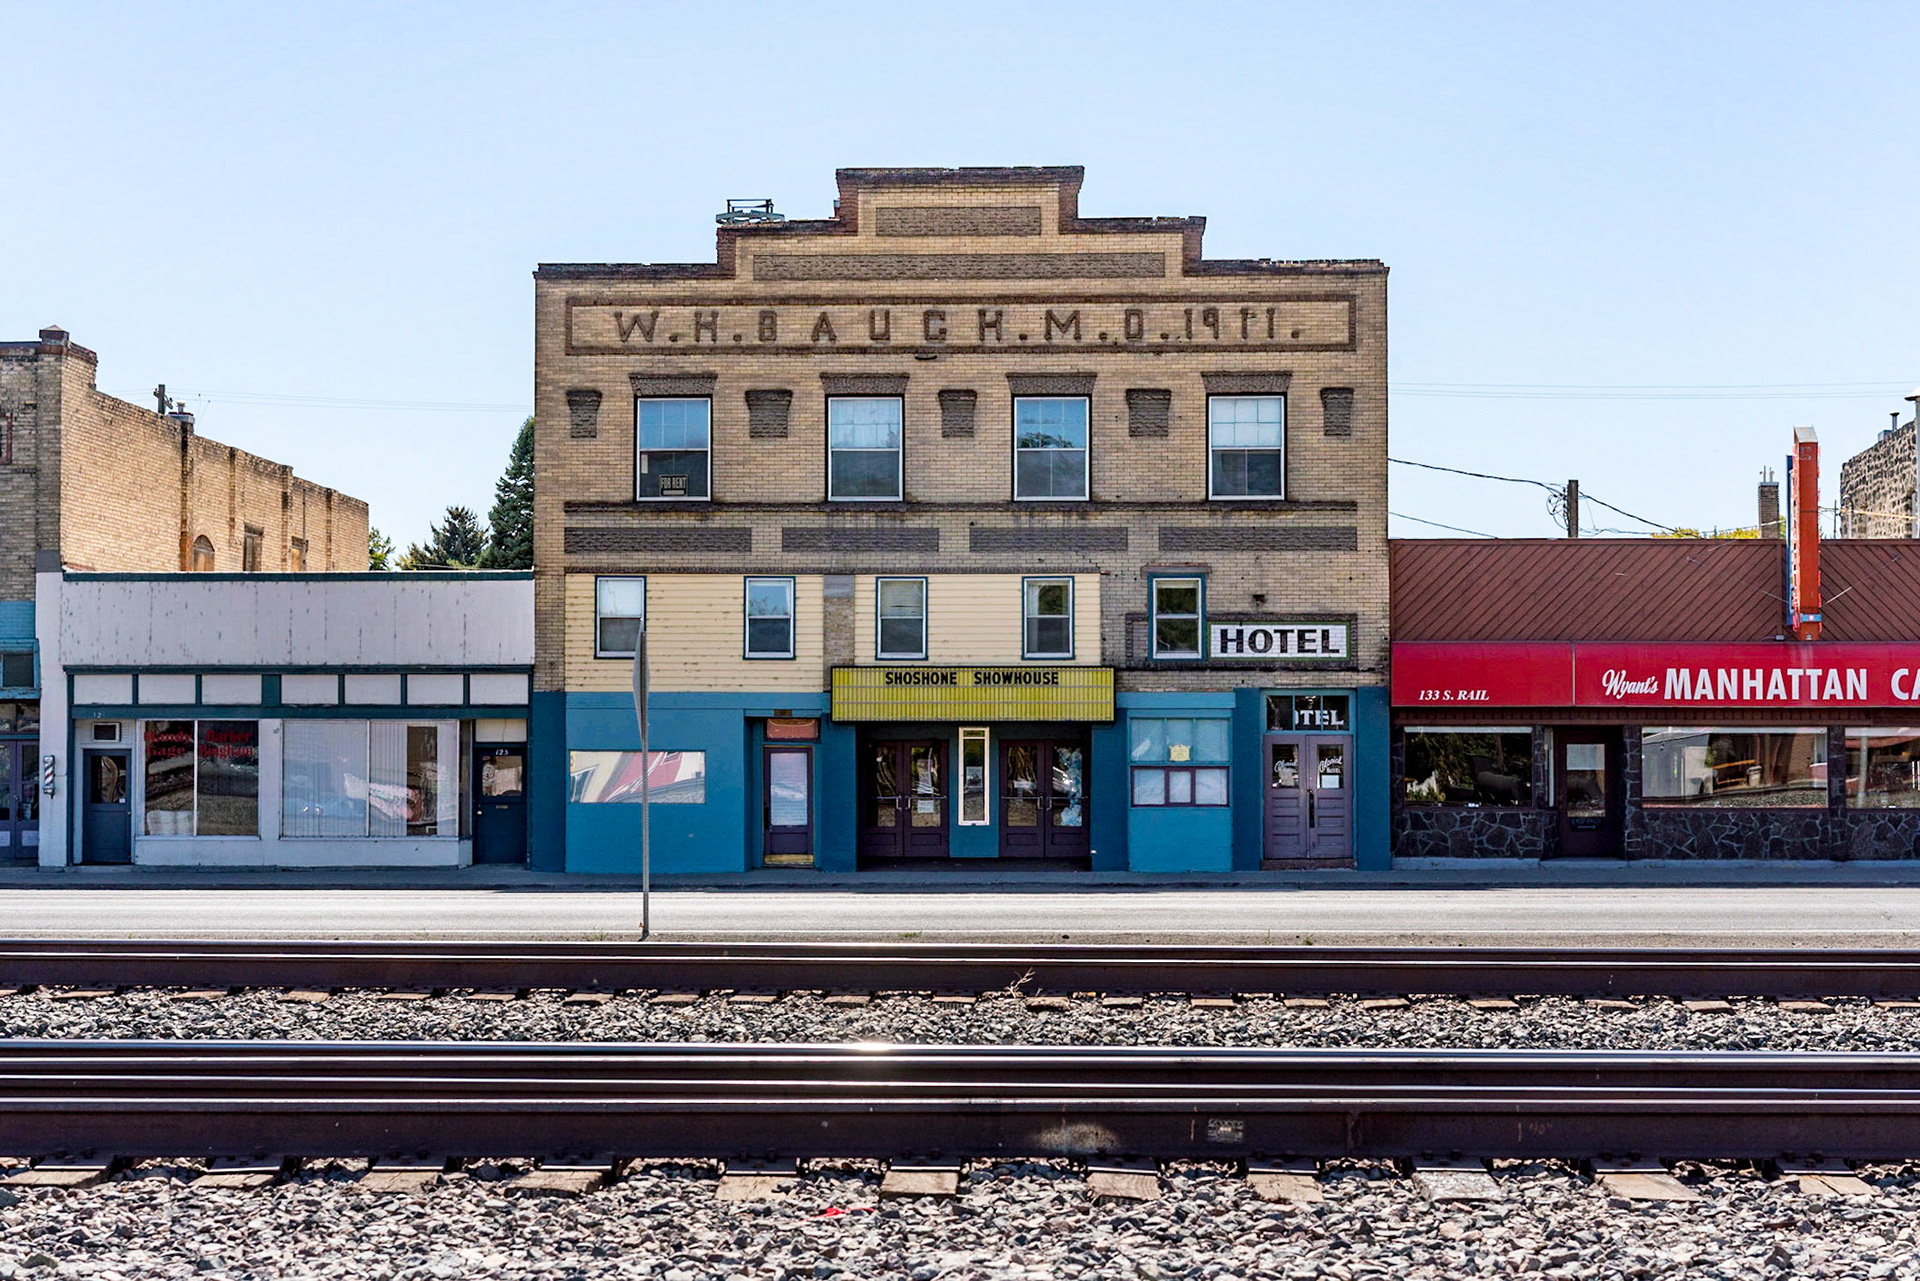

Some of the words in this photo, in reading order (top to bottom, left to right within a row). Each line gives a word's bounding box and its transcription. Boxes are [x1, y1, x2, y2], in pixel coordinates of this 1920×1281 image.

[660, 477, 671, 489] FOR
[672, 477, 686, 489] RENT
[1220, 628, 1340, 654] HOTEL
[885, 671, 958, 685] SHOSHONE
[974, 671, 1059, 685] SHOWHOUSE
[1602, 669, 1659, 699] Wyant's
[1664, 668, 1868, 700] MANHATTAN
[1419, 689, 1440, 701] 133
[1442, 689, 1454, 701] S.
[1456, 689, 1490, 701] RAIL
[206, 729, 253, 743] Barber
